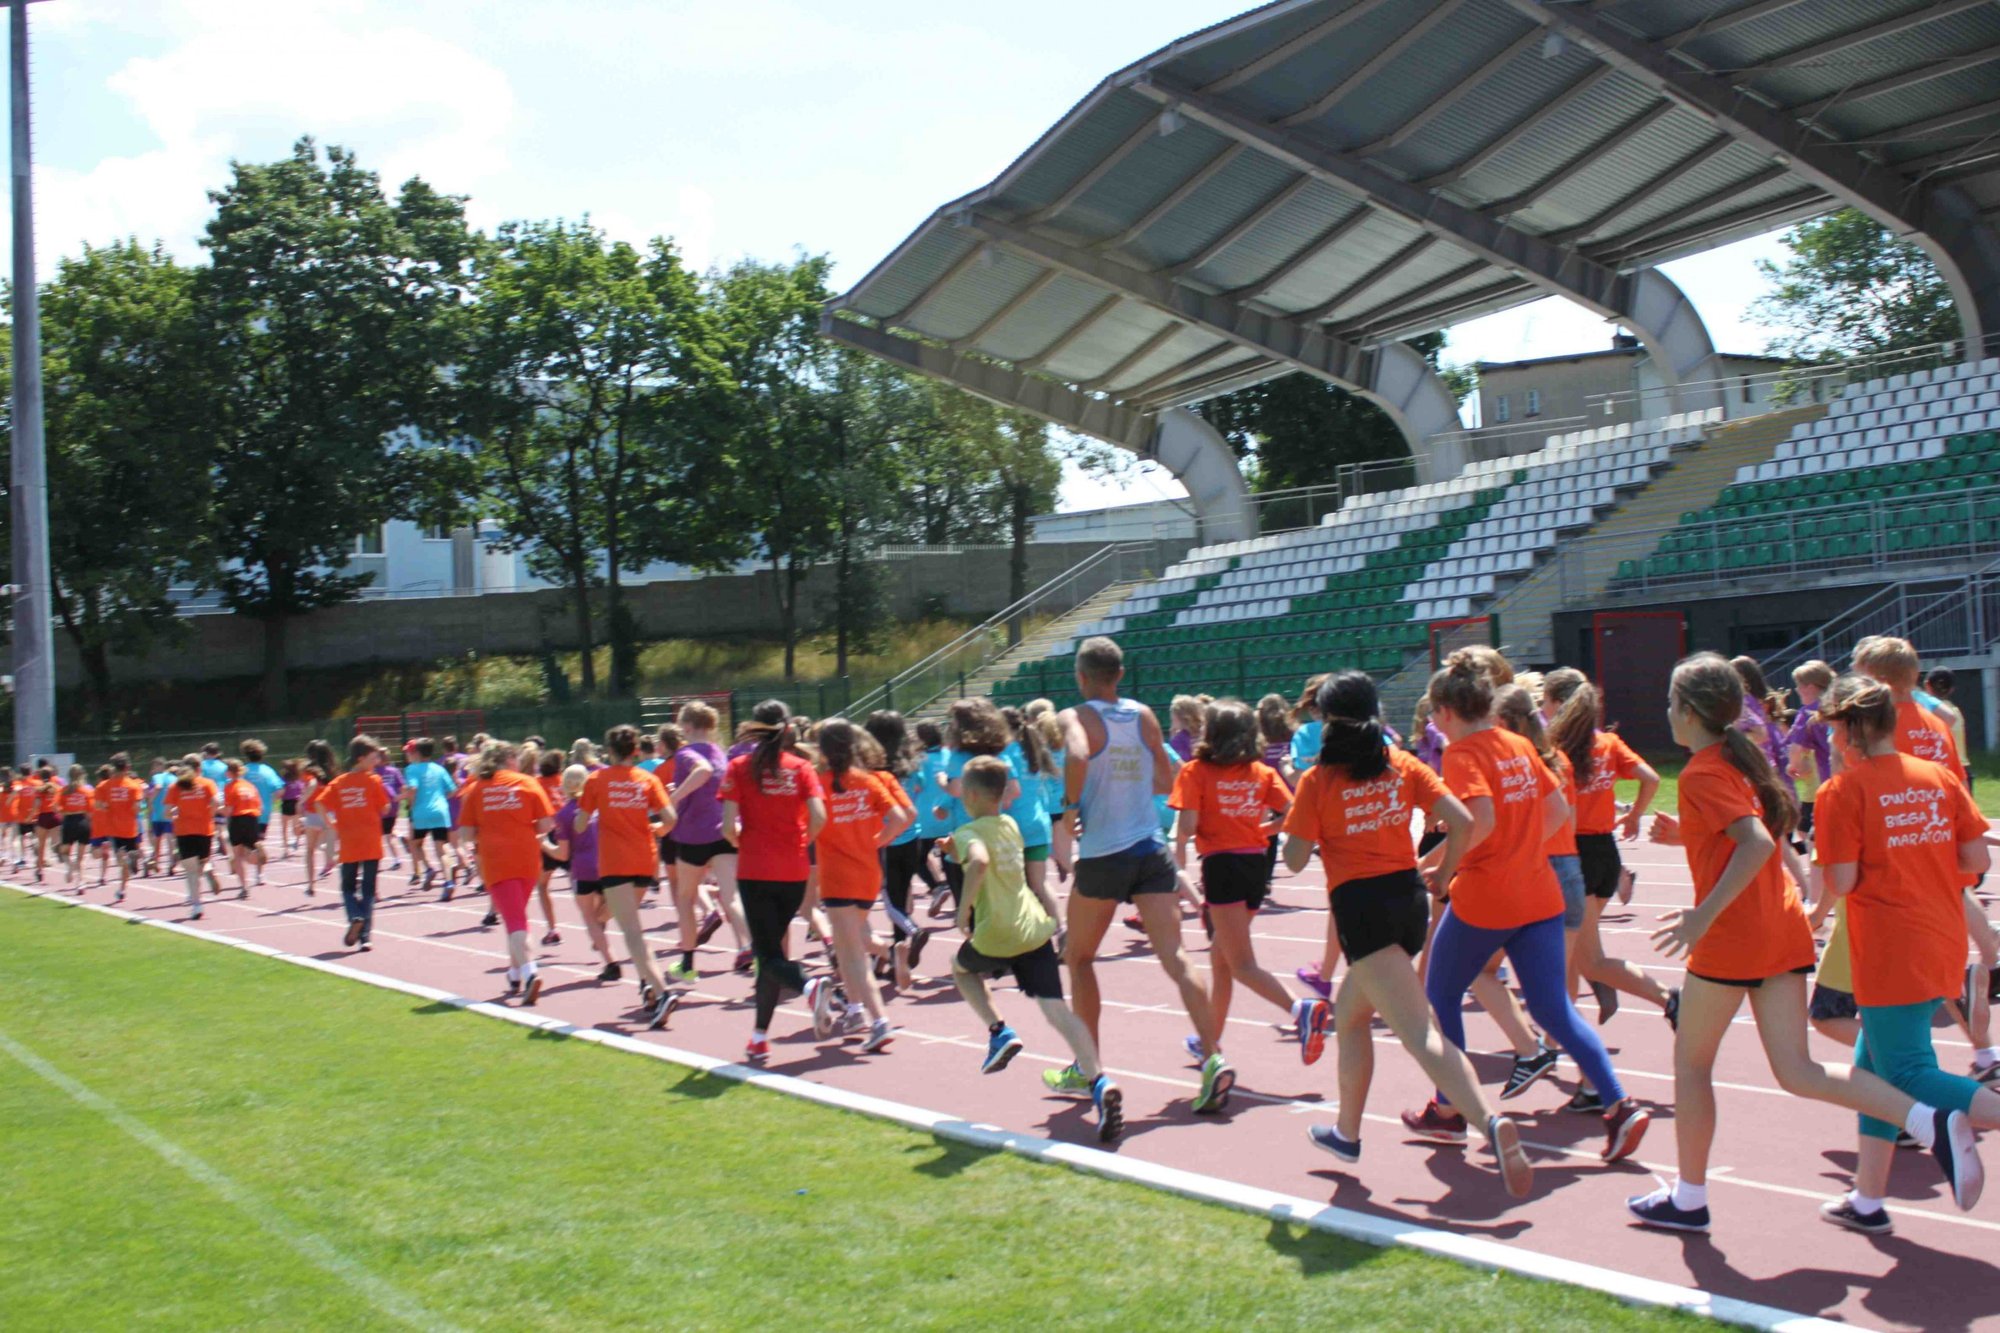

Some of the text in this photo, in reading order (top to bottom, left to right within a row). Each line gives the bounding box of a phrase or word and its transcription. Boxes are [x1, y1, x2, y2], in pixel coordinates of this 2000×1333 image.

[1342, 778, 1404, 801] DWÓJKA
[1879, 787, 1946, 807] DWÓJKA
[1344, 801, 1384, 819] BIEGA
[1884, 812, 1927, 828] BIEGA
[1887, 829, 1952, 848] MARATON
